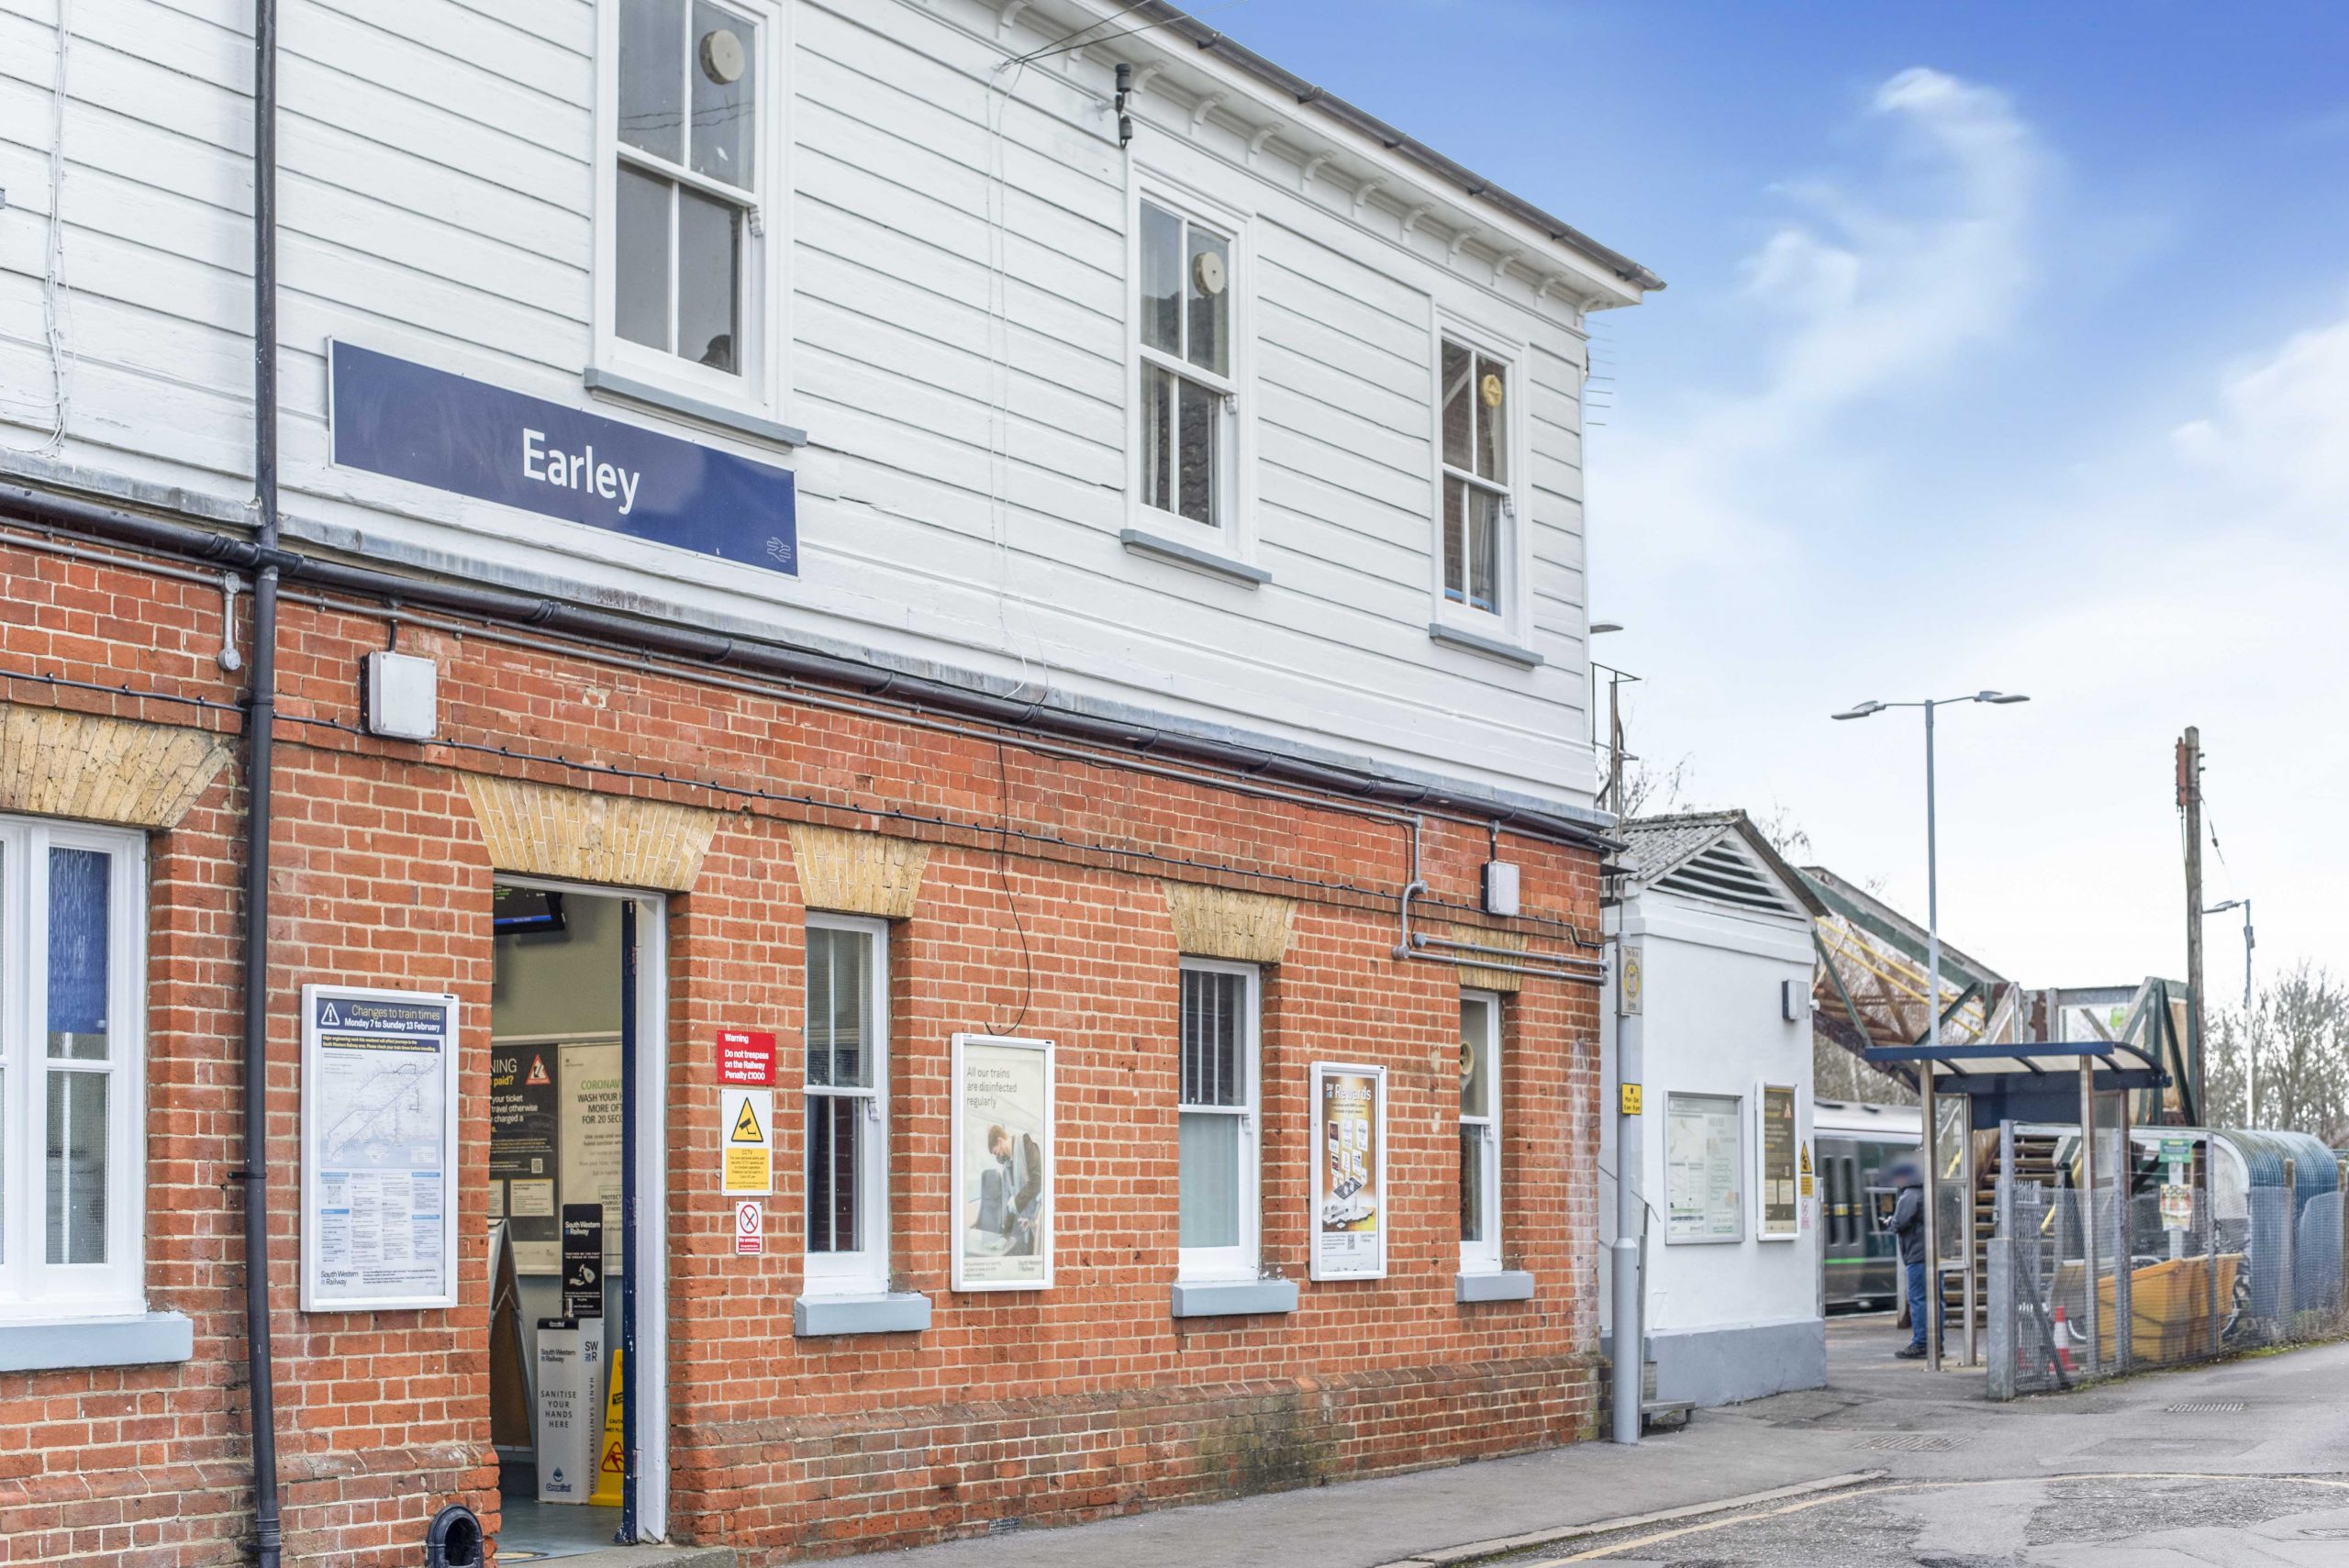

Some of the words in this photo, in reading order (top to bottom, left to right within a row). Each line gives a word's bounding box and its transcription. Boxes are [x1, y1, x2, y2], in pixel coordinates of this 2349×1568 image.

[523, 428, 640, 515] Earley
[351, 1005, 387, 1019] Changes
[389, 1007, 397, 1018] to
[398, 1007, 417, 1018] train
[417, 1008, 440, 1020] times
[345, 1018, 369, 1029] Monday
[383, 1019, 406, 1031] Sunday
[406, 1021, 413, 1029] 13
[414, 1021, 440, 1032] February
[724, 1033, 749, 1044] Warning
[725, 1050, 733, 1058] Do
[733, 1050, 744, 1058] not
[744, 1050, 769, 1060] trespass
[491, 1058, 518, 1073] NING
[743, 1061, 765, 1071] Railway
[725, 1071, 747, 1081] Penalty
[748, 1072, 765, 1080] £1000
[967, 1066, 976, 1077] All
[978, 1070, 989, 1078] our
[990, 1067, 1010, 1078] trains
[494, 1075, 514, 1088] paid?
[581, 1079, 621, 1090] CORONAV
[966, 1083, 978, 1092] are
[979, 1082, 1017, 1093] disinfected
[1335, 1084, 1372, 1101] Rewards
[492, 1095, 505, 1104] your
[578, 1094, 597, 1103] WASH
[598, 1093, 618, 1101] YOUR
[966, 1095, 996, 1108] regularly
[492, 1105, 507, 1113] travel
[508, 1104, 538, 1112] otherwise
[588, 1104, 609, 1113] MORE
[611, 1103, 622, 1112] OFT
[494, 1115, 518, 1124] charged
[582, 1115, 596, 1124] FOR
[597, 1115, 606, 1124] 20
[607, 1114, 623, 1123] SECO
[570, 1228, 590, 1237] Railway
[326, 1278, 347, 1286] Railway
[584, 1340, 598, 1351] SW
[545, 1355, 564, 1364] Railway
[592, 1351, 597, 1362] R
[540, 1390, 577, 1398] SANITISE
[547, 1400, 570, 1408] YOUR
